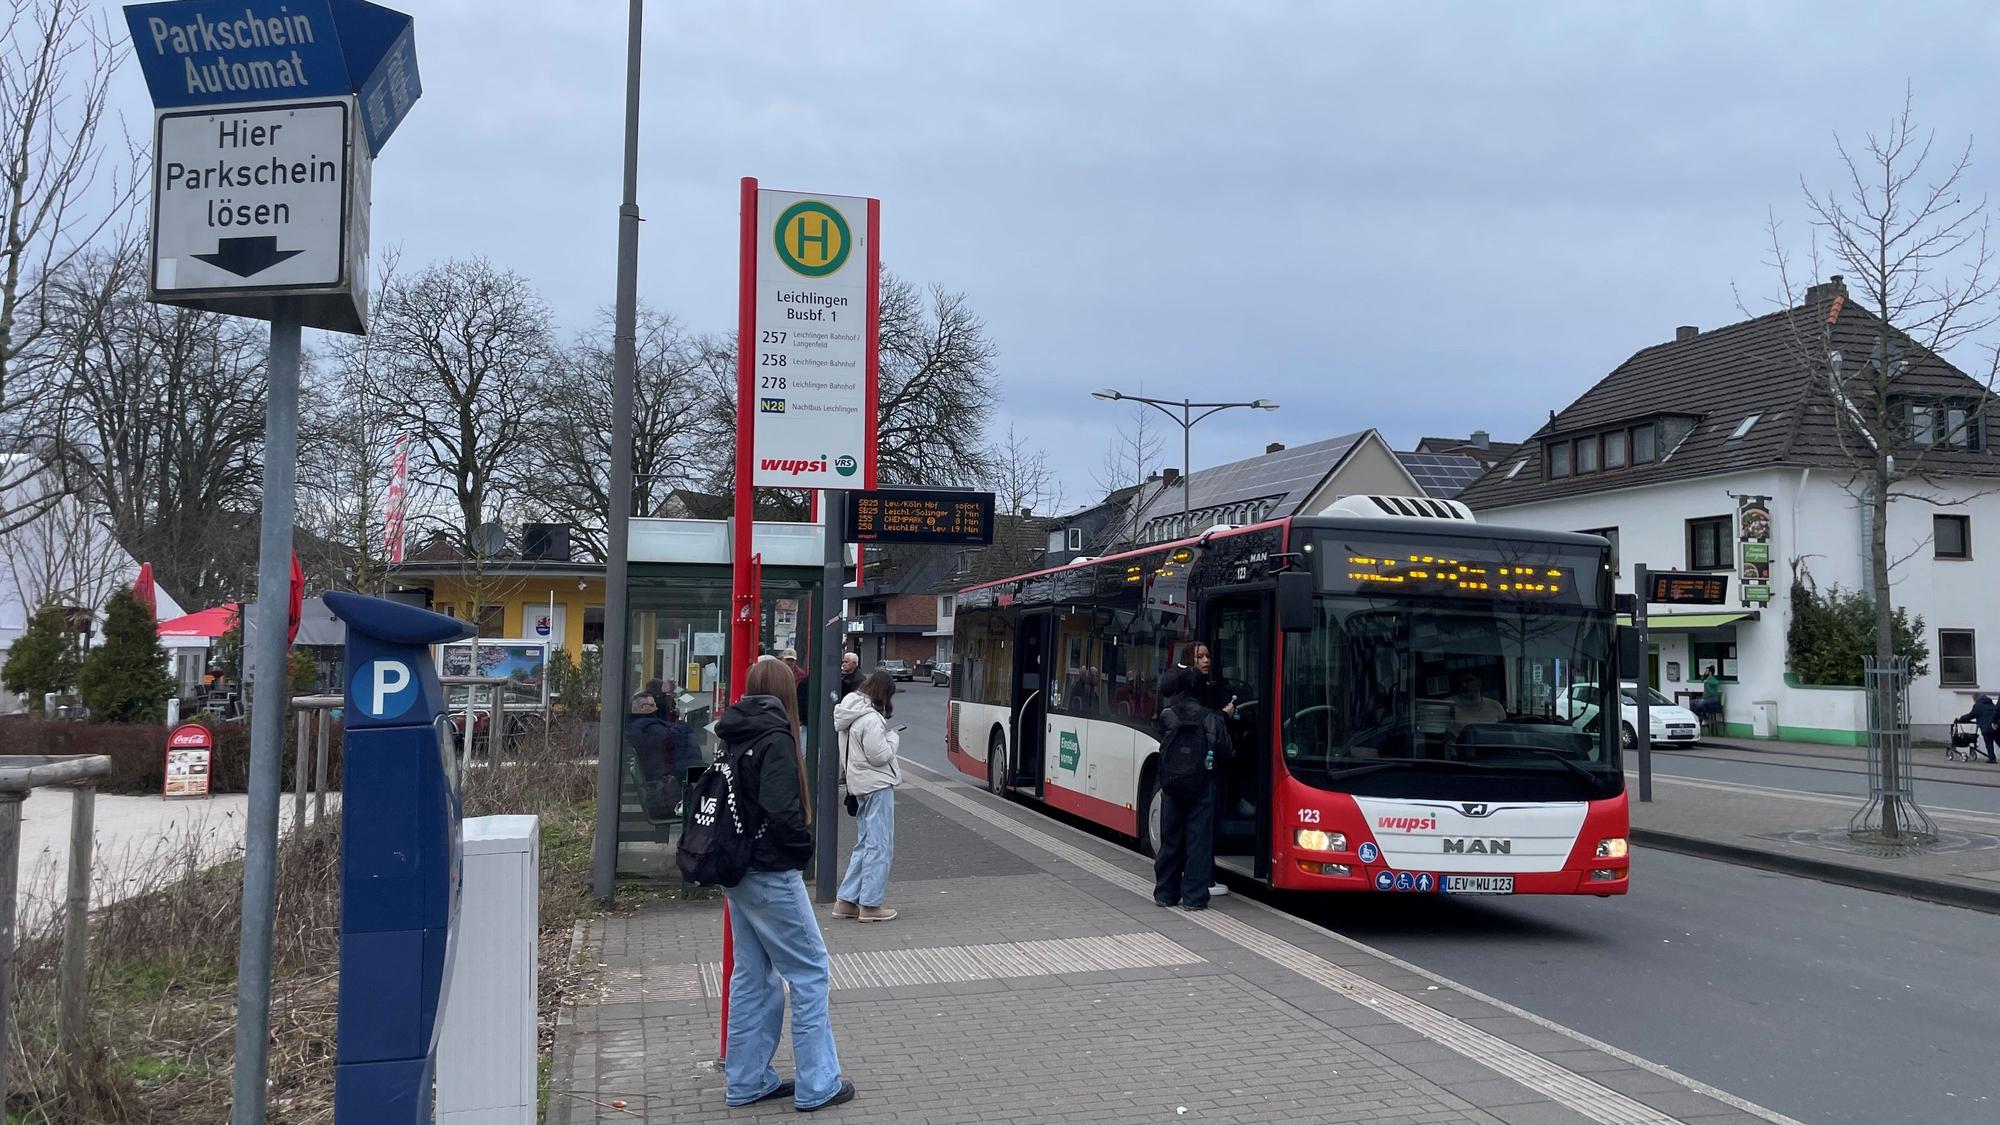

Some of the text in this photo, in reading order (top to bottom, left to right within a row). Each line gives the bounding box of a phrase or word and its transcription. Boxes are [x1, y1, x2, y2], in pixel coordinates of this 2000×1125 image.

[148, 6, 314, 55] Parkschein
[185, 50, 308, 94] Automat
[219, 119, 282, 149] Hier
[166, 154, 336, 190] Parkschein
[208, 199, 290, 228] lösen
[798, 217, 828, 260] H
[777, 290, 848, 308] Leichlingen
[787, 308, 836, 322] Busbf. 1
[762, 331, 787, 344] 257
[794, 332, 829, 340] Leichlingen
[794, 341, 828, 349] Langenfeld
[762, 354, 787, 366] 258
[793, 359, 828, 368] Leichlingen
[762, 377, 787, 389] 278
[792, 381, 828, 390] Leichlingen
[761, 400, 785, 411] N28
[823, 405, 858, 414] Leichlingen
[761, 454, 827, 475] wupsi
[1250, 552, 1267, 562] MAN
[1237, 566, 1246, 580] 123
[372, 661, 410, 714] P
[1297, 809, 1320, 823] 123
[1378, 812, 1436, 833] wupsi
[1443, 838, 1511, 854] MAN
[1448, 878, 1512, 890] LEV WU 123
